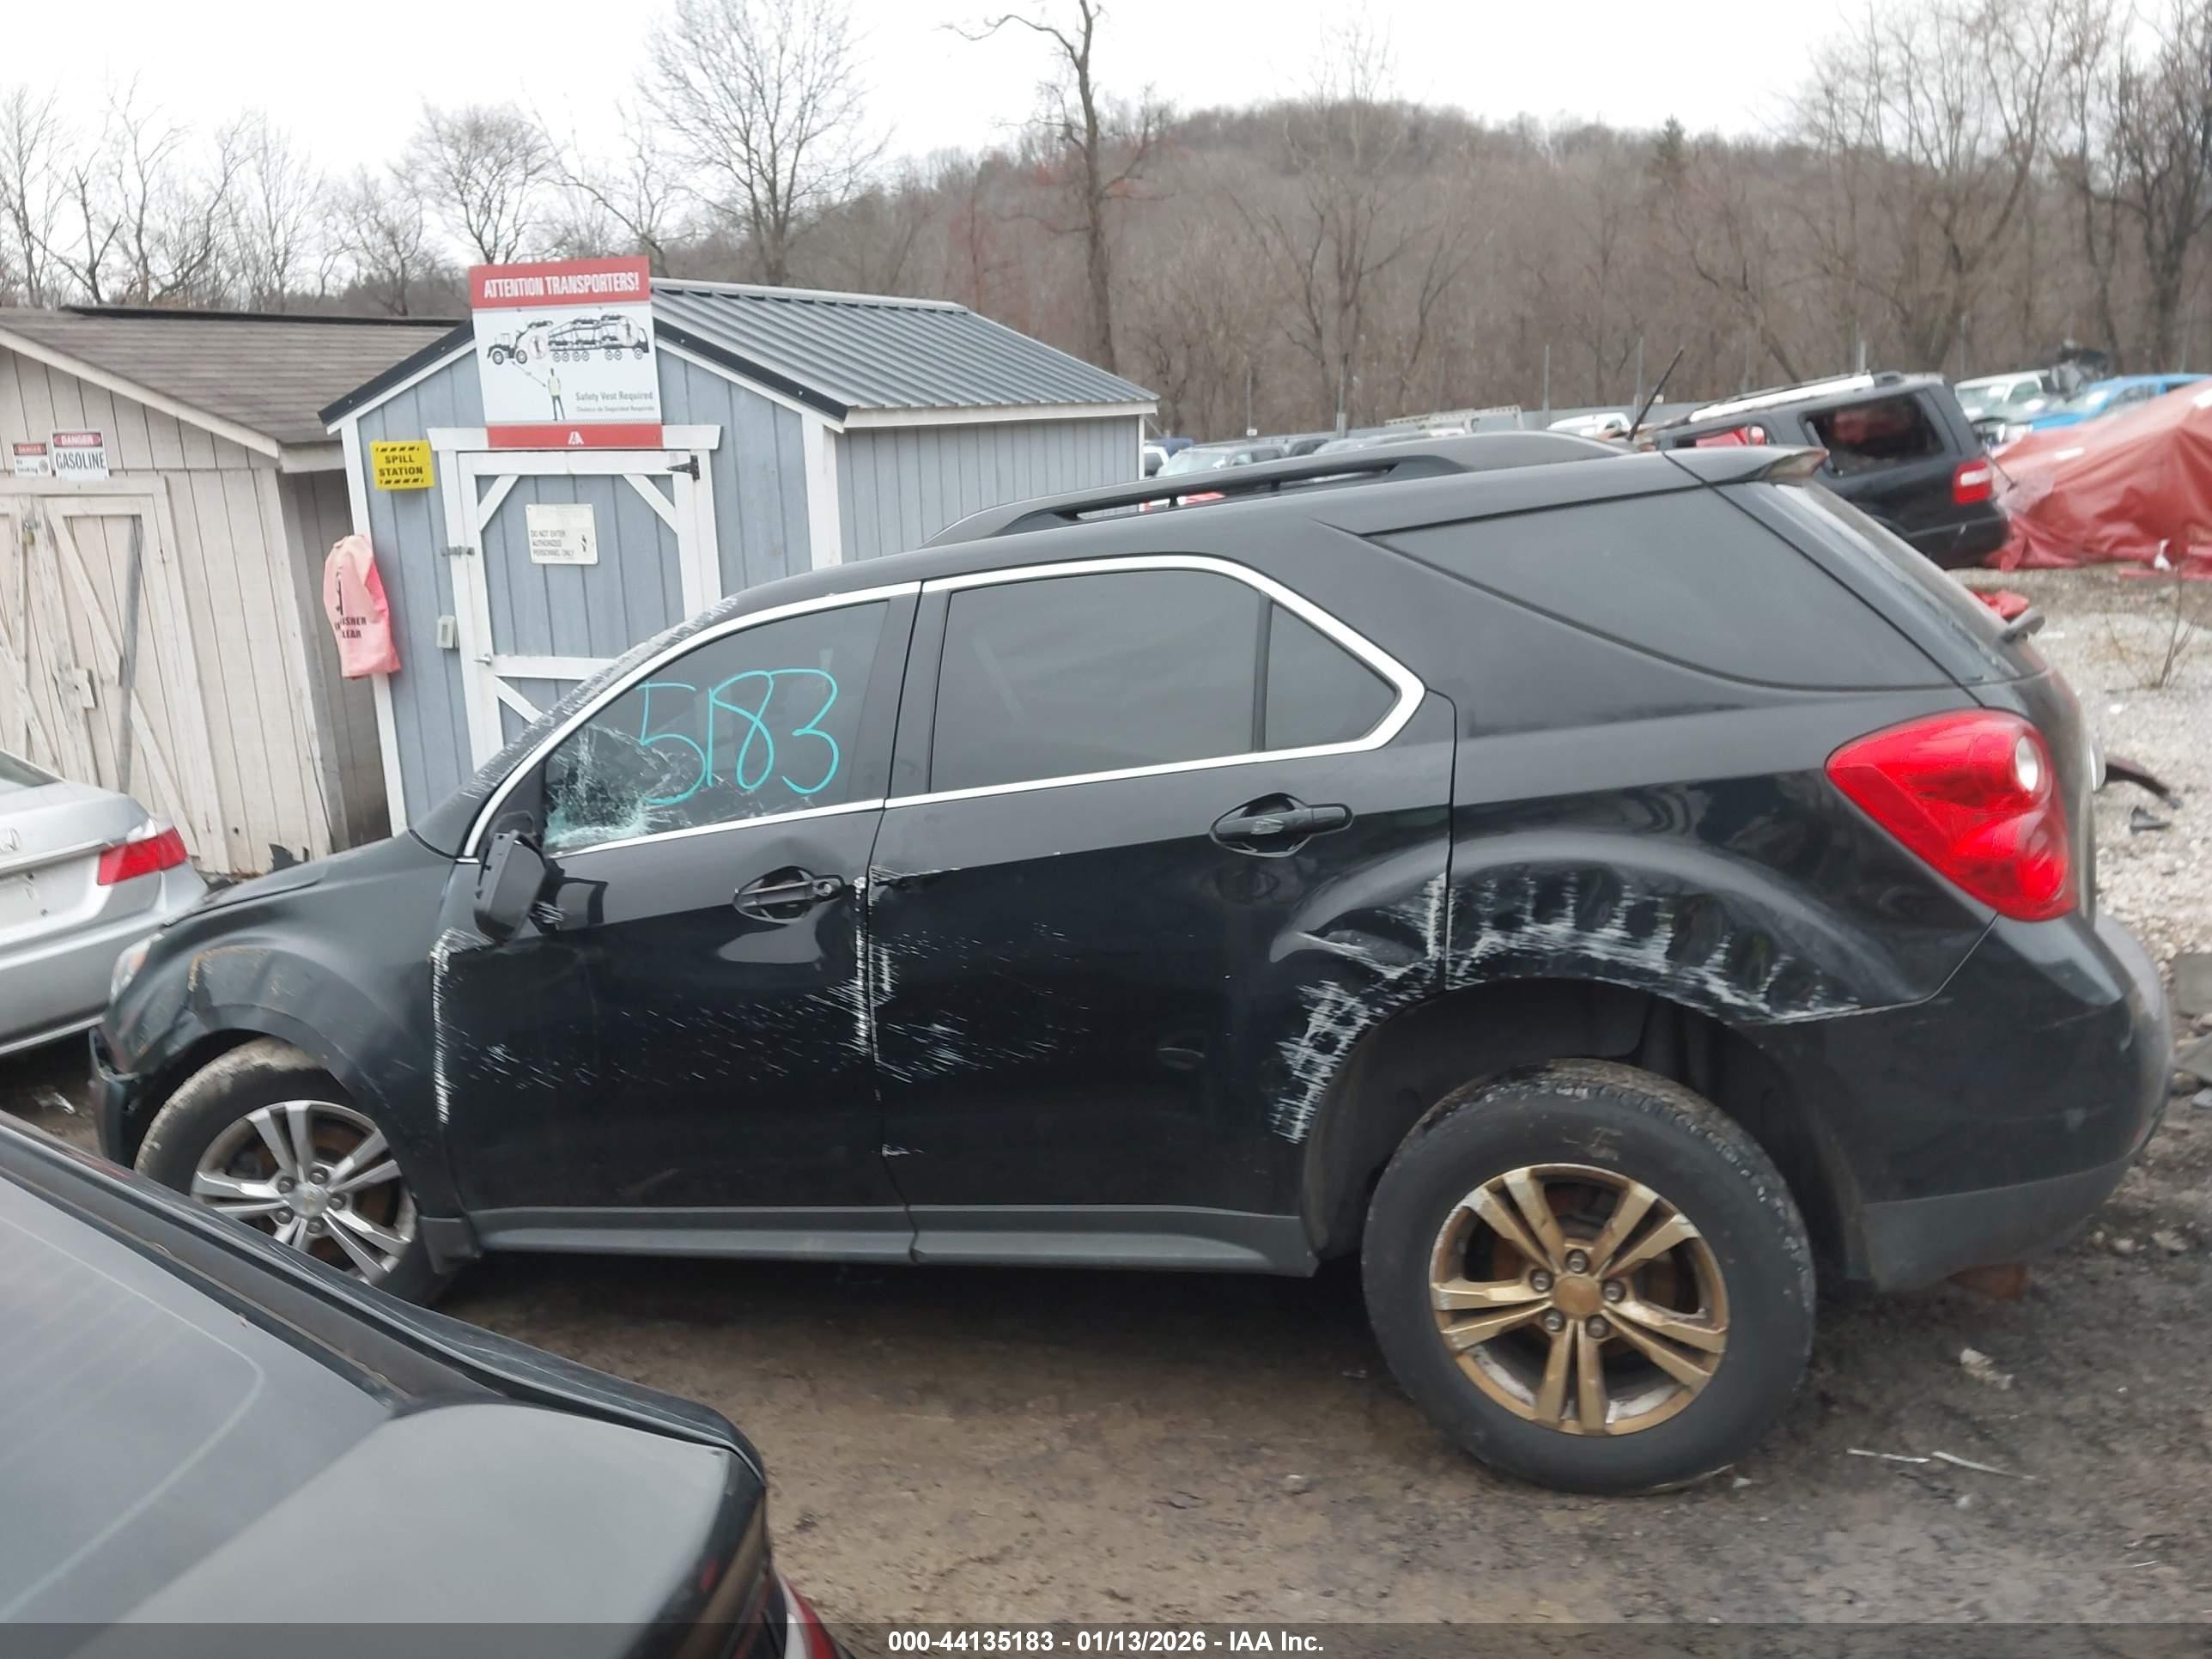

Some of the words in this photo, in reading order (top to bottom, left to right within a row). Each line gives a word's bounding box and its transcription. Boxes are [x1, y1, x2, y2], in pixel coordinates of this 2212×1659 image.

[483, 276, 544, 298] ATTENTION
[545, 272, 640, 295] TRANSPORTERS!
[575, 391, 599, 402] Safety
[600, 392, 617, 400] Vest
[618, 391, 653, 401] Required
[61, 434, 94, 446] DANGER
[55, 451, 106, 470] GASOLINE
[385, 454, 414, 464] SPILL
[379, 466, 422, 477] STATION
[636, 667, 841, 805] 5183
